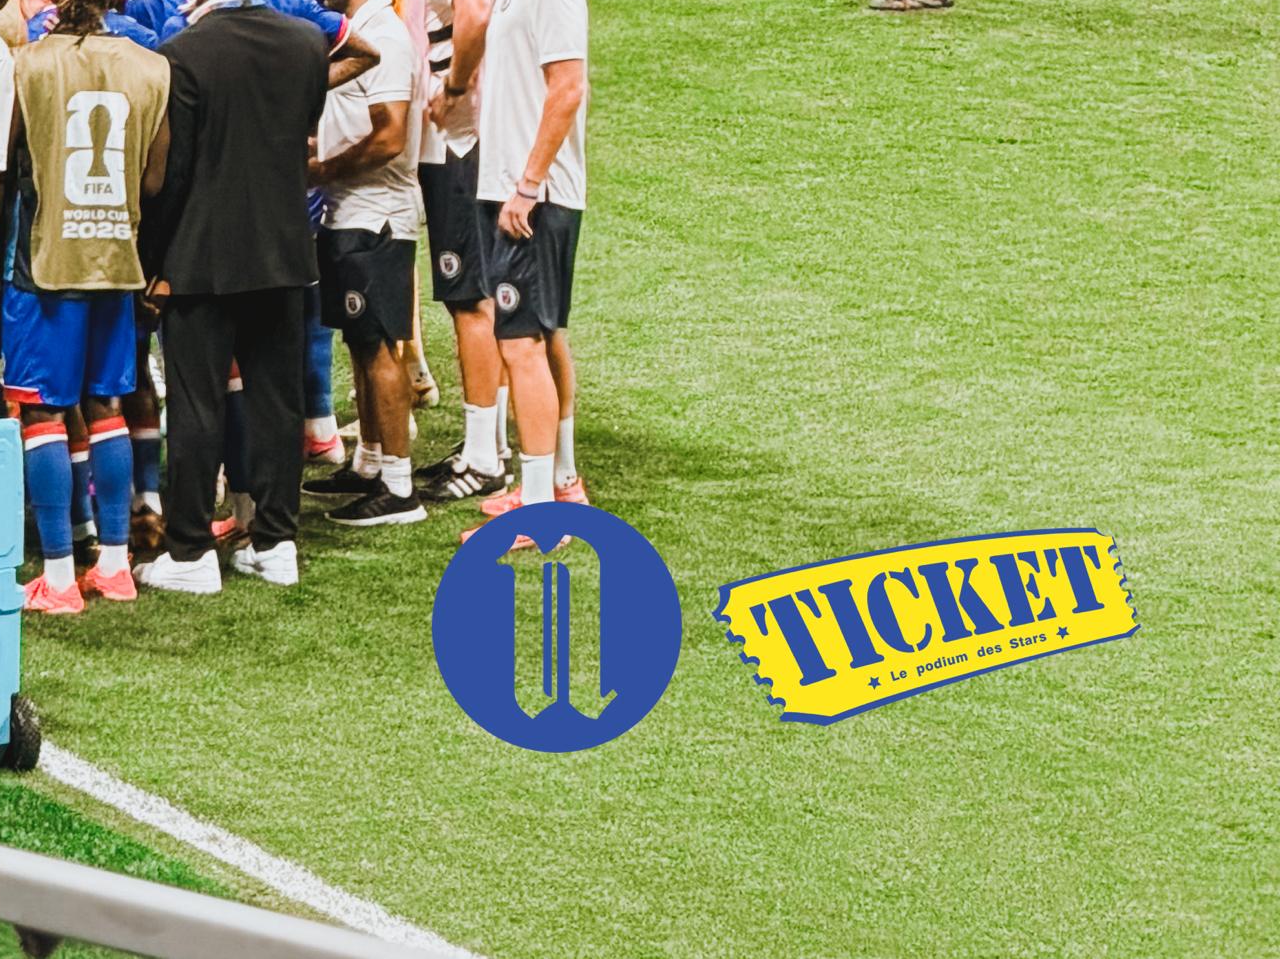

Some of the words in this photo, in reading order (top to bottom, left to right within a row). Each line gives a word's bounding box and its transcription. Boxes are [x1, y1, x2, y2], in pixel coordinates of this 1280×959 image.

[83, 183, 113, 195] FIFA
[63, 208, 106, 221] WORLD
[62, 221, 132, 240] 2026
